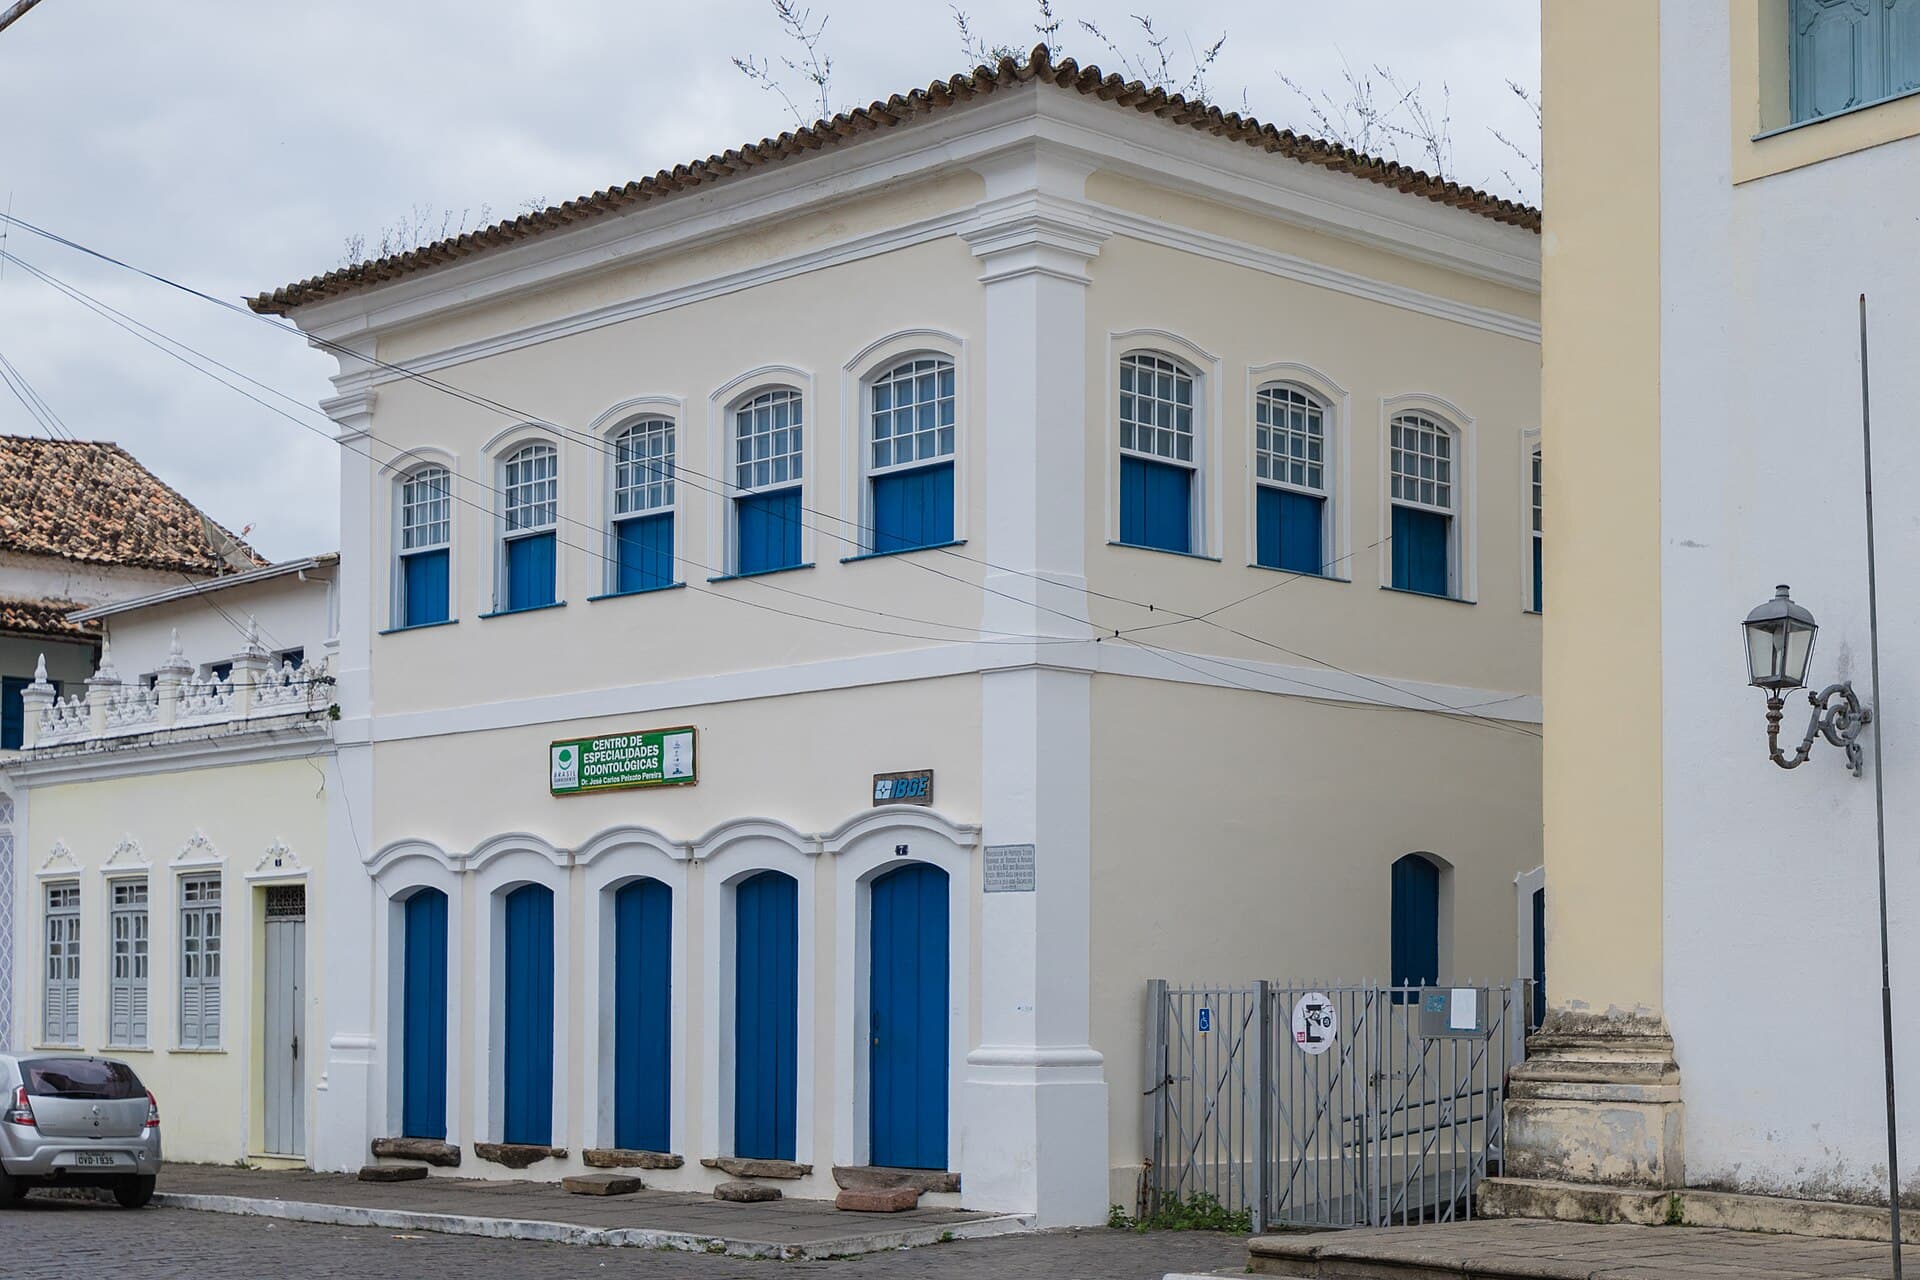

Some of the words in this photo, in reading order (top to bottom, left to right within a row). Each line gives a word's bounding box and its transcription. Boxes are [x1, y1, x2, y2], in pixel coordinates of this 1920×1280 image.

[592, 736, 628, 751] CENTRO
[630, 735, 643, 747] DE
[583, 744, 659, 764] ESPECIALIDADES
[584, 757, 658, 776] ODONTOLÓGICAS
[603, 774, 620, 784] Carlos
[620, 773, 642, 782] Peixoto
[642, 771, 662, 780] Pereira
[890, 776, 930, 799] IBGE
